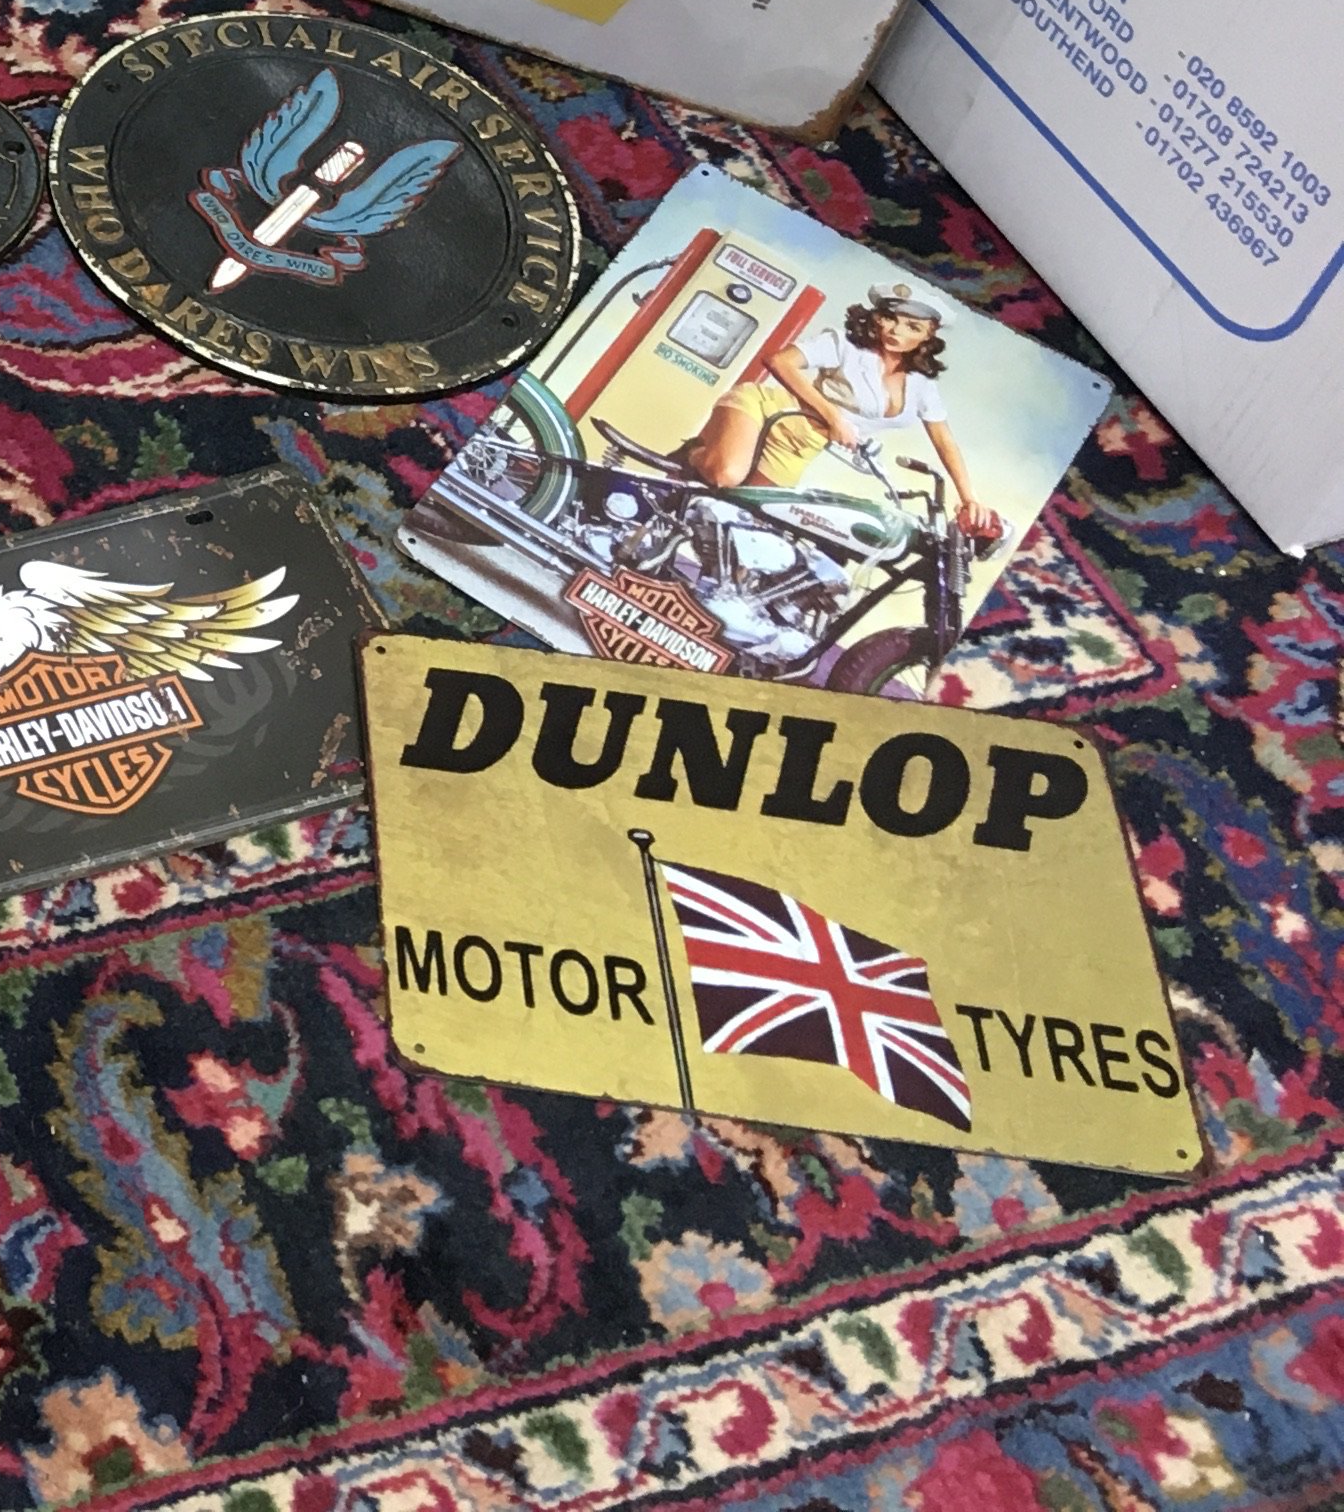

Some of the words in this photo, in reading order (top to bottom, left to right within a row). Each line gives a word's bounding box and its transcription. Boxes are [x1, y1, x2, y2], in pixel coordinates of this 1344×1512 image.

[118, 19, 359, 85] SPECIAL
[370, 46, 475, 114] AIR
[470, 111, 564, 315] SERVICE
[1225, 96, 1279, 155] 8592
[1280, 150, 1332, 208] 1003
[1234, 142, 1310, 225] 724213
[201, 195, 230, 225] WHO
[226, 231, 275, 265] DARES
[285, 258, 330, 278] WINS
[1203, 191, 1281, 268] 436967
[1218, 166, 1295, 249] 215530
[66, 143, 125, 243] WHO
[109, 250, 274, 366] DARES
[287, 341, 442, 382] WINS
[724, 249, 746, 270] FULL
[746, 261, 789, 291] SERVICE
[673, 352, 717, 385] SMOKING
[579, 580, 719, 673] HARLEY-DAVIDSON
[626, 582, 700, 633] MOTOR
[32, 745, 155, 805] CYCLES
[399, 666, 1090, 853] DUNLOP
[394, 925, 658, 1026] MOTOR
[955, 1003, 1183, 1100] TYRES
